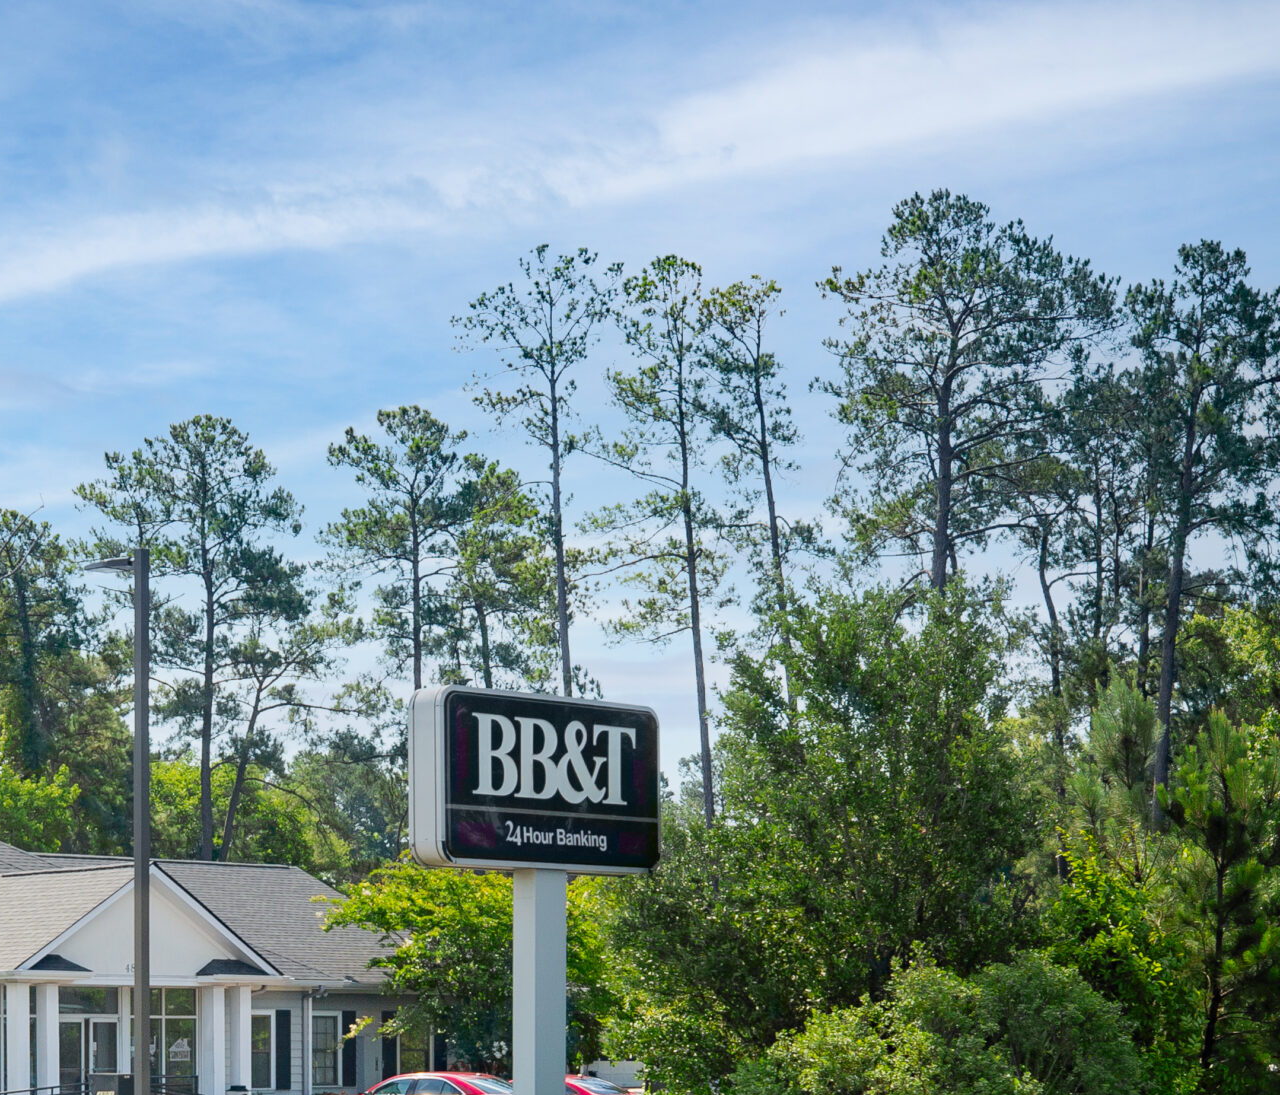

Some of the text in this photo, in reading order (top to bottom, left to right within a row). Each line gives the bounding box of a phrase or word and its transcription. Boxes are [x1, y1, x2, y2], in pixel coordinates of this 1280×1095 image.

[472, 712, 636, 805] BB&T
[505, 820, 607, 852] 24 Hour Banking
